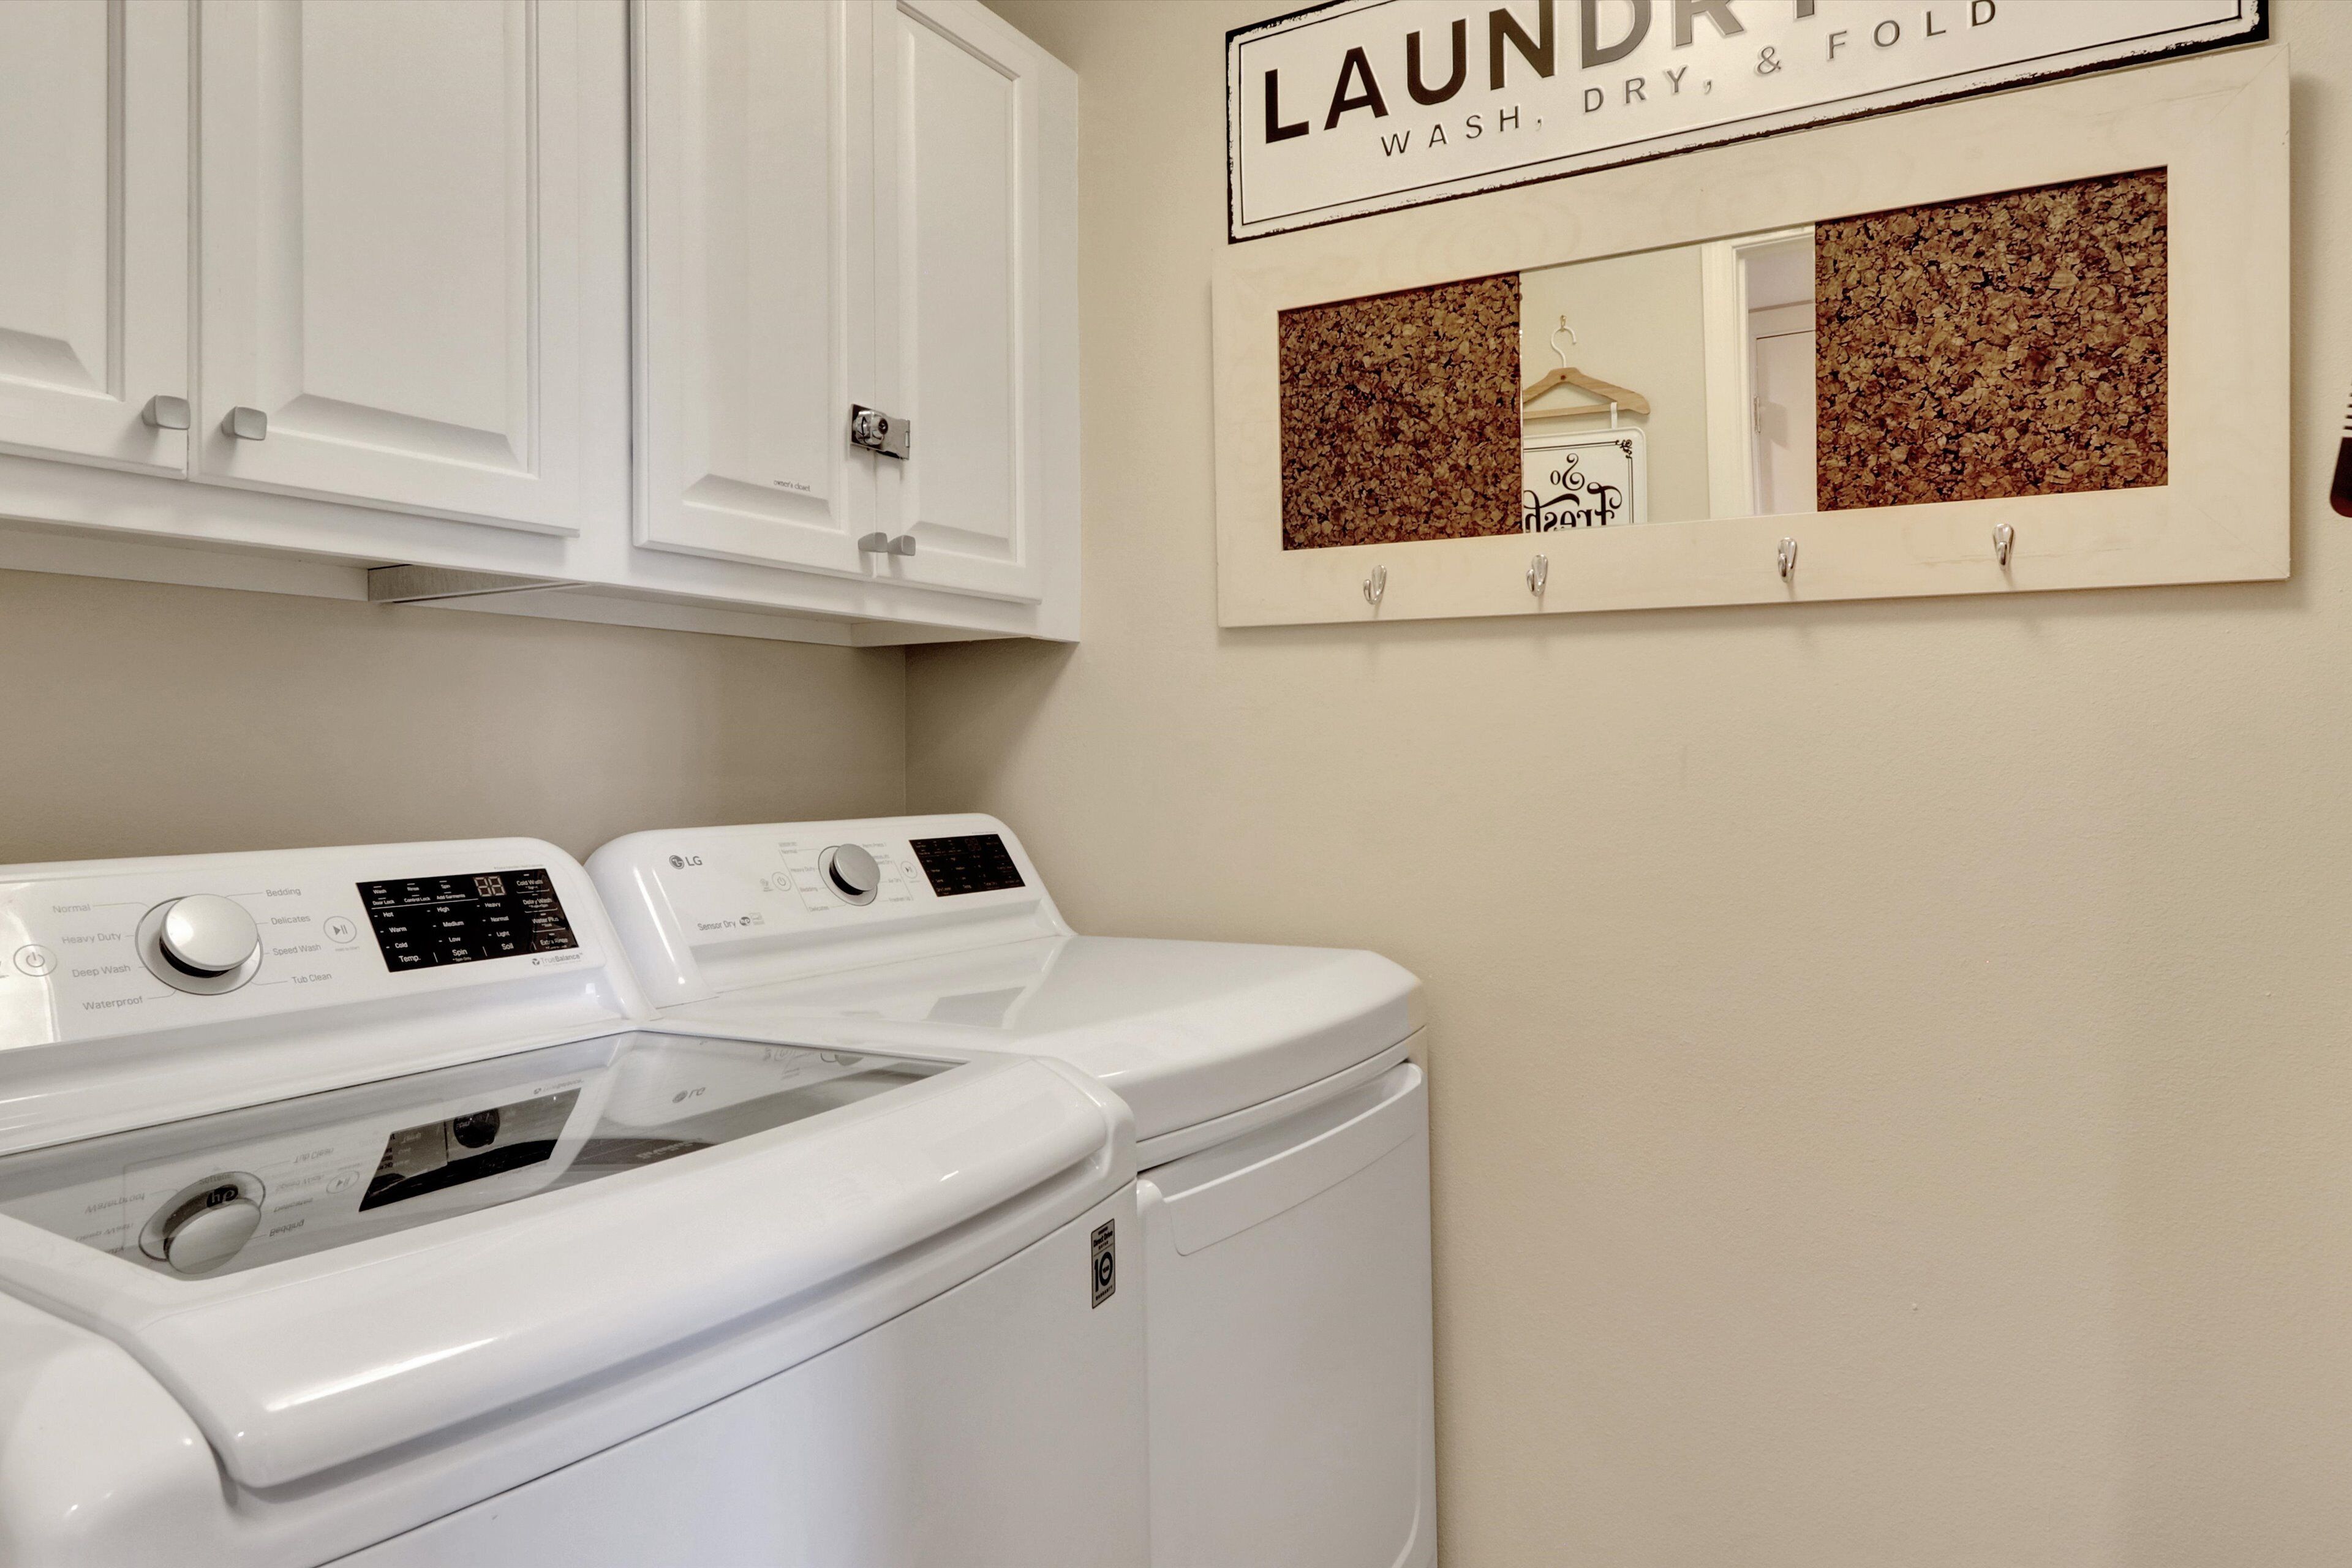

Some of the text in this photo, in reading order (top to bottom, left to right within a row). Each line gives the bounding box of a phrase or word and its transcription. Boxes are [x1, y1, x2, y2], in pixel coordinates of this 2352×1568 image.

[1265, 0, 1815, 143] LAUNDR
[1380, 0, 1997, 157] WASH, DRY, & FOLD
[685, 856, 703, 867] LG
[265, 886, 302, 899] Bedding
[53, 903, 91, 914] Normal
[270, 914, 311, 925] Delicates
[698, 920, 736, 931] Sensor Dry
[61, 932, 122, 946] Heavy Duty
[272, 943, 322, 957] Speed Wash
[452, 948, 468, 957] Spin
[398, 954, 421, 963] Temp.
[72, 964, 131, 979] Deep Wash
[291, 971, 333, 985] Tub Clean
[82, 995, 144, 1011] Waterproof
[1094, 1251, 1113, 1292] 10
